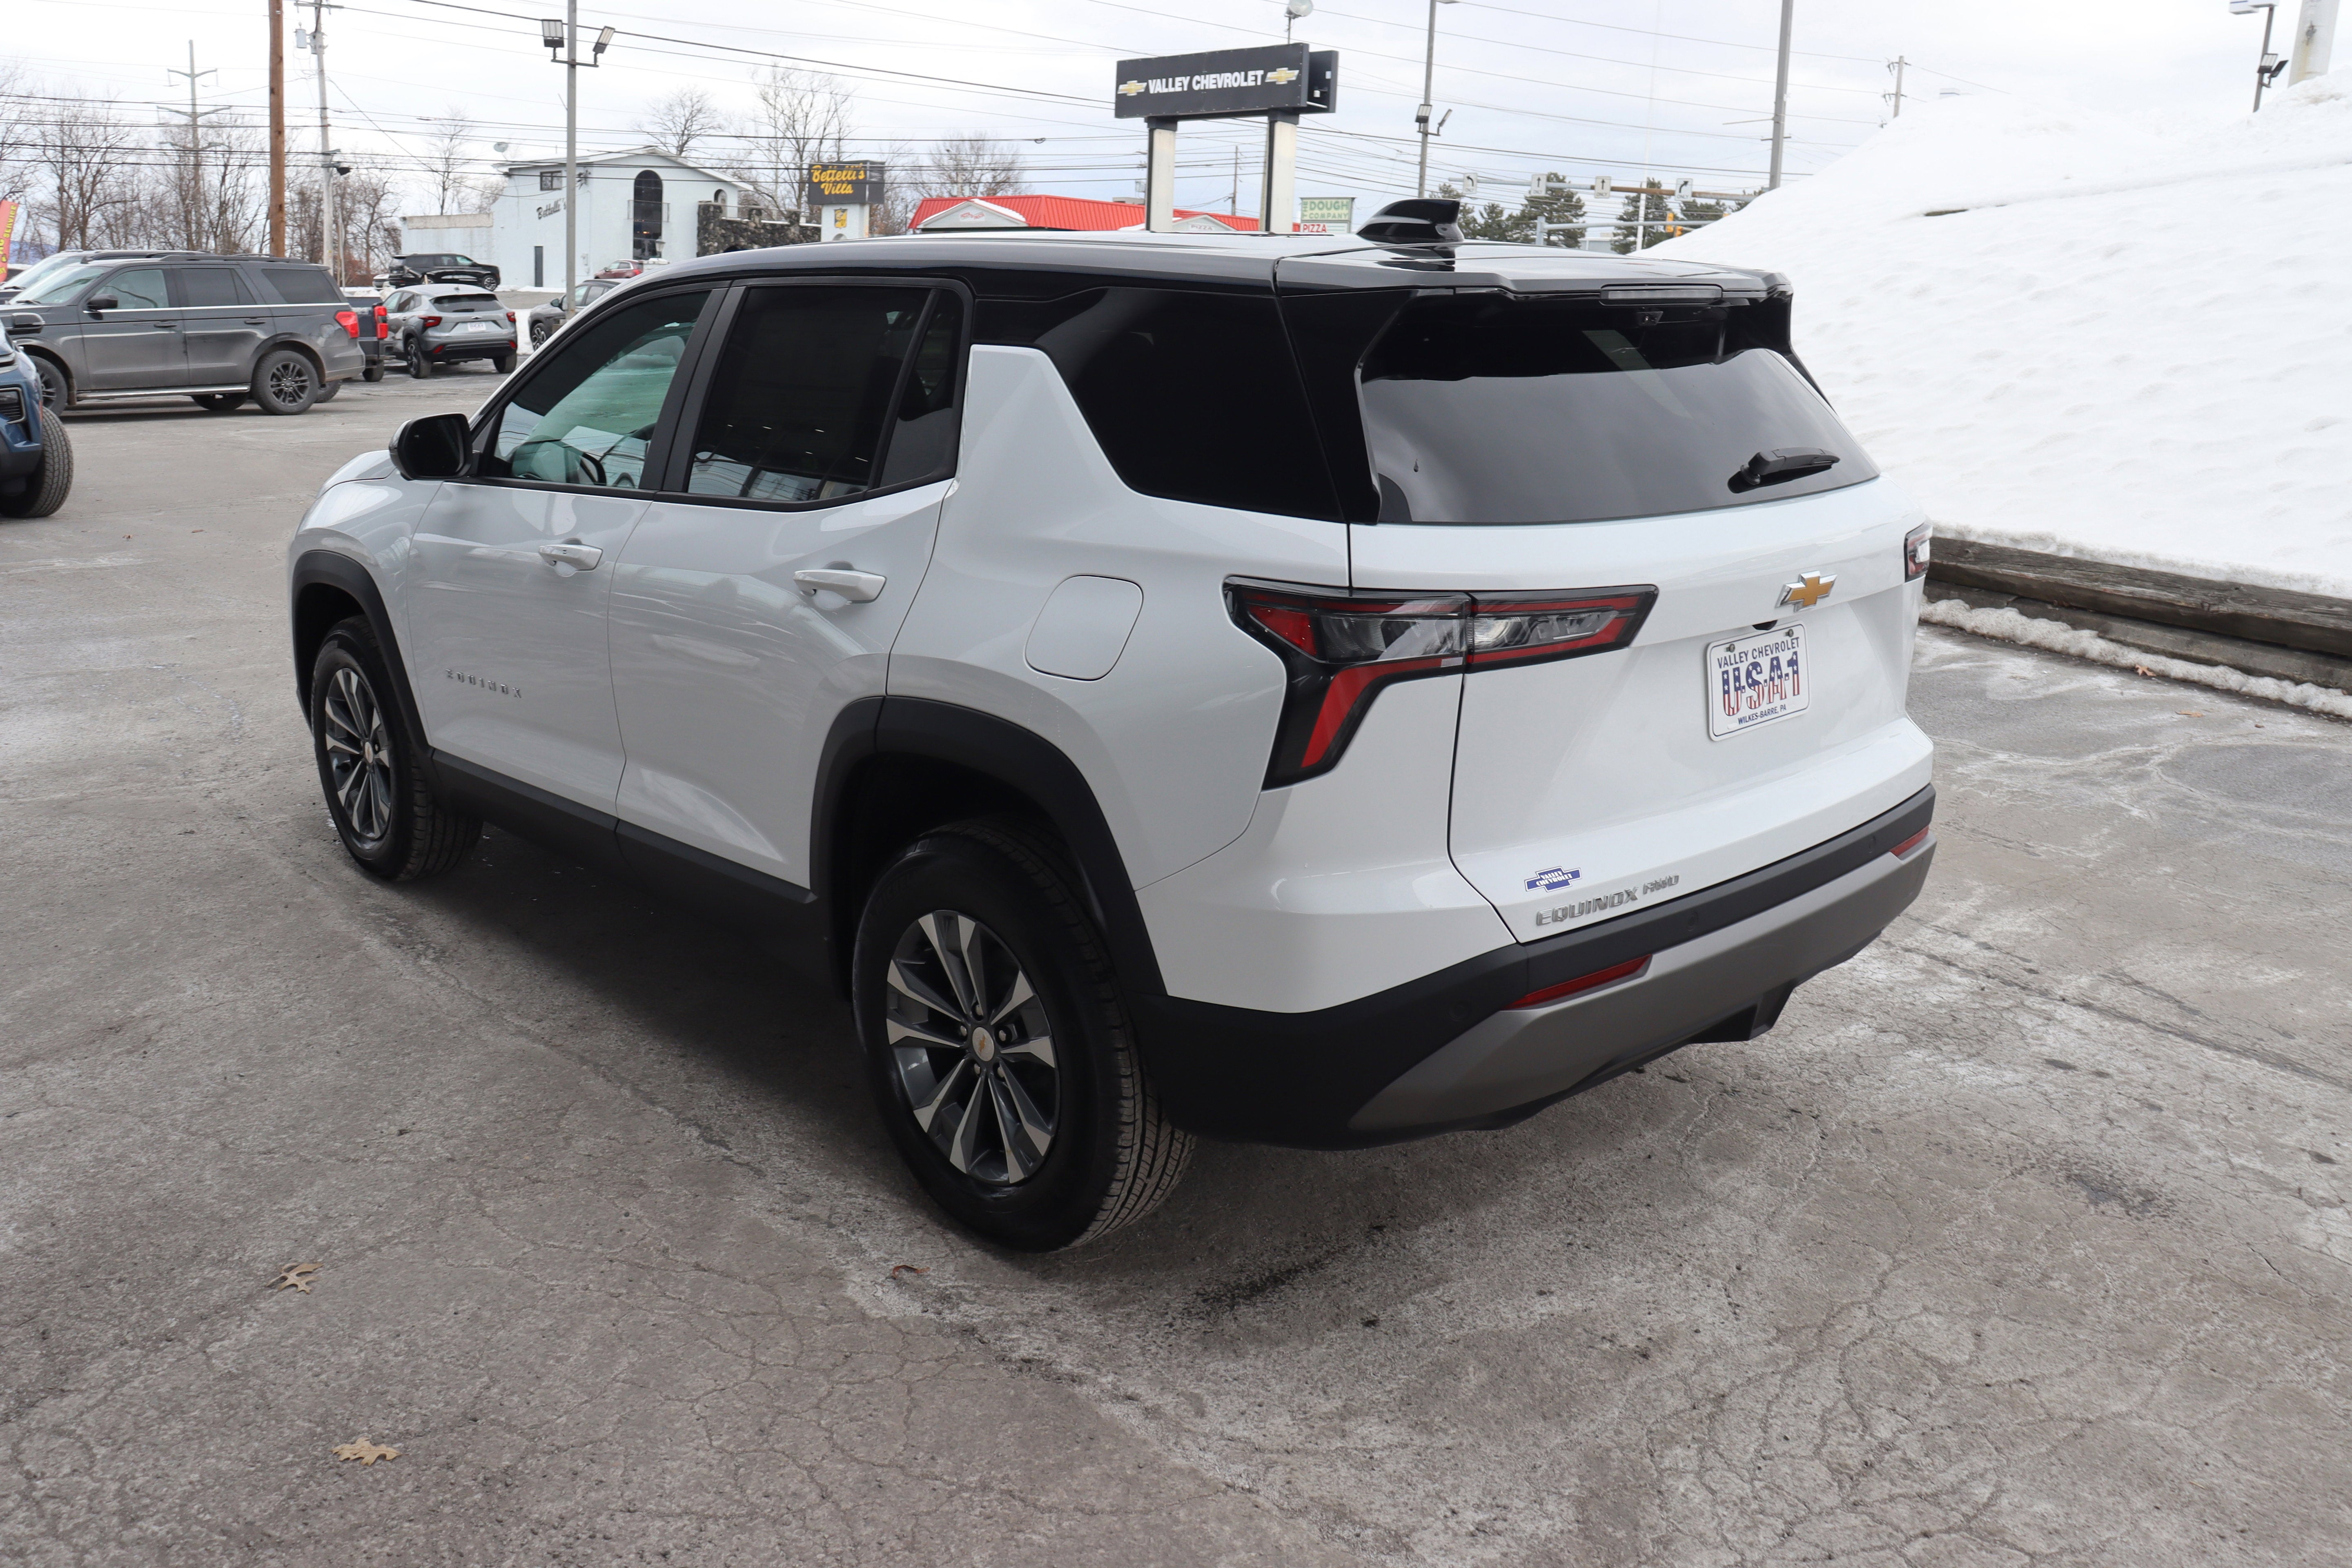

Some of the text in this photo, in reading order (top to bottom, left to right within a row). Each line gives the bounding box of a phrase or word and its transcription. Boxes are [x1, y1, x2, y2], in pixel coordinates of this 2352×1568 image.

[1148, 70, 1264, 94] VALLEY CHEVROLET
[820, 181, 854, 195] Villa
[1309, 200, 1350, 211] DOUGH
[1303, 223, 1327, 233] PIZZA
[1717, 637, 1800, 669] VALLEY CHEVROLET
[445, 669, 522, 699] EQUINOX
[1780, 704, 1787, 712] PA
[1536, 873, 1573, 886] CHEVROLET
[1540, 871, 1563, 880] VALLEY
[1536, 873, 1680, 926] EQUINOX AWD
